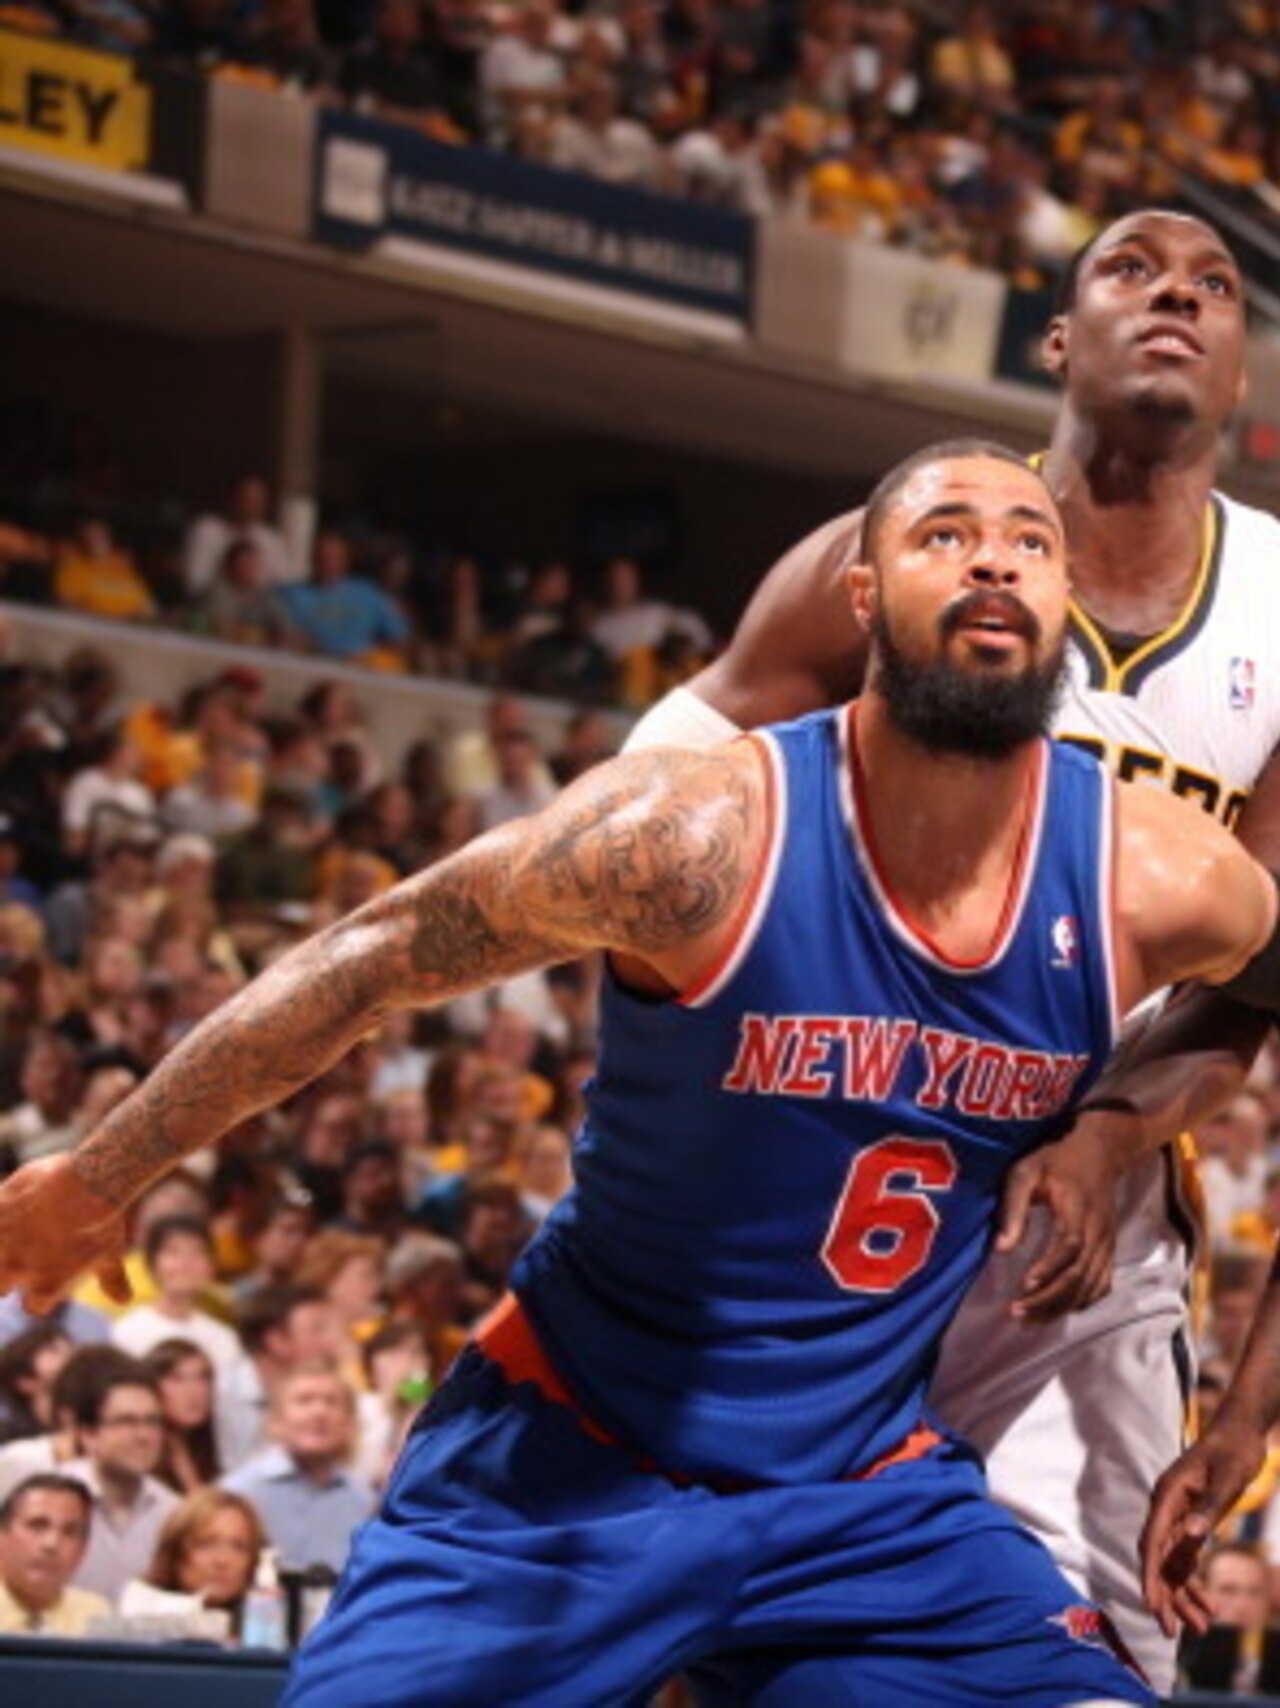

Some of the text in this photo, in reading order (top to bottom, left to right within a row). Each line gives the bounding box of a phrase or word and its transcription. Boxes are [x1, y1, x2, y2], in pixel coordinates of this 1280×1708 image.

[722, 1012, 1091, 1121] NEW YORK
[819, 1134, 958, 1293] 6
